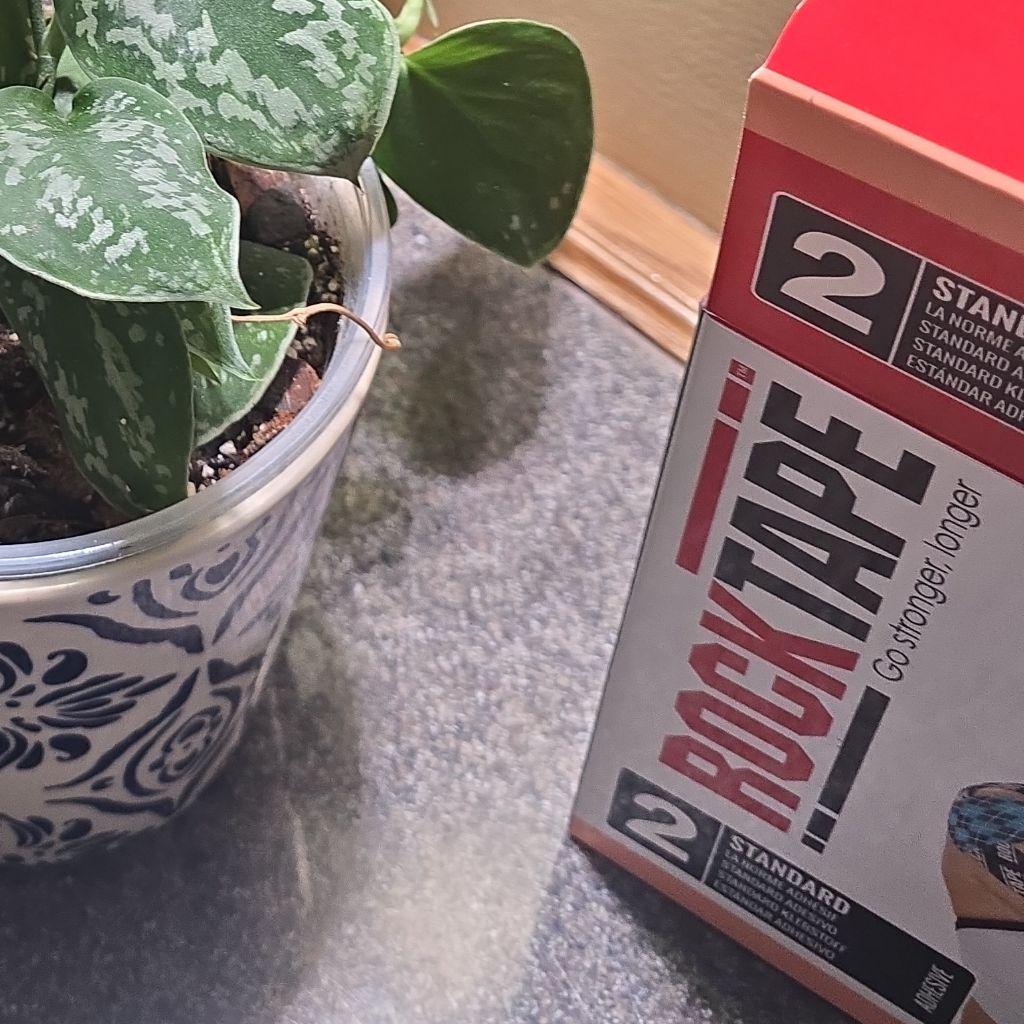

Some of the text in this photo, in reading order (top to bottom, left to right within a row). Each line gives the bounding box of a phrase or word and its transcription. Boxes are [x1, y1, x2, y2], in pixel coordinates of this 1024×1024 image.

[779, 230, 886, 336] 2
[919, 319, 1010, 372] STANDARD
[925, 301, 945, 321] LA
[948, 312, 1014, 353] NORME
[906, 354, 993, 406] ESTÁNDAR
[912, 337, 1003, 389] STANDARD
[872, 477, 983, 682] Go stronger, longer
[624, 791, 698, 864] 2
[729, 834, 851, 915] STANDARD
[913, 963, 955, 1015] ADHESIVE
